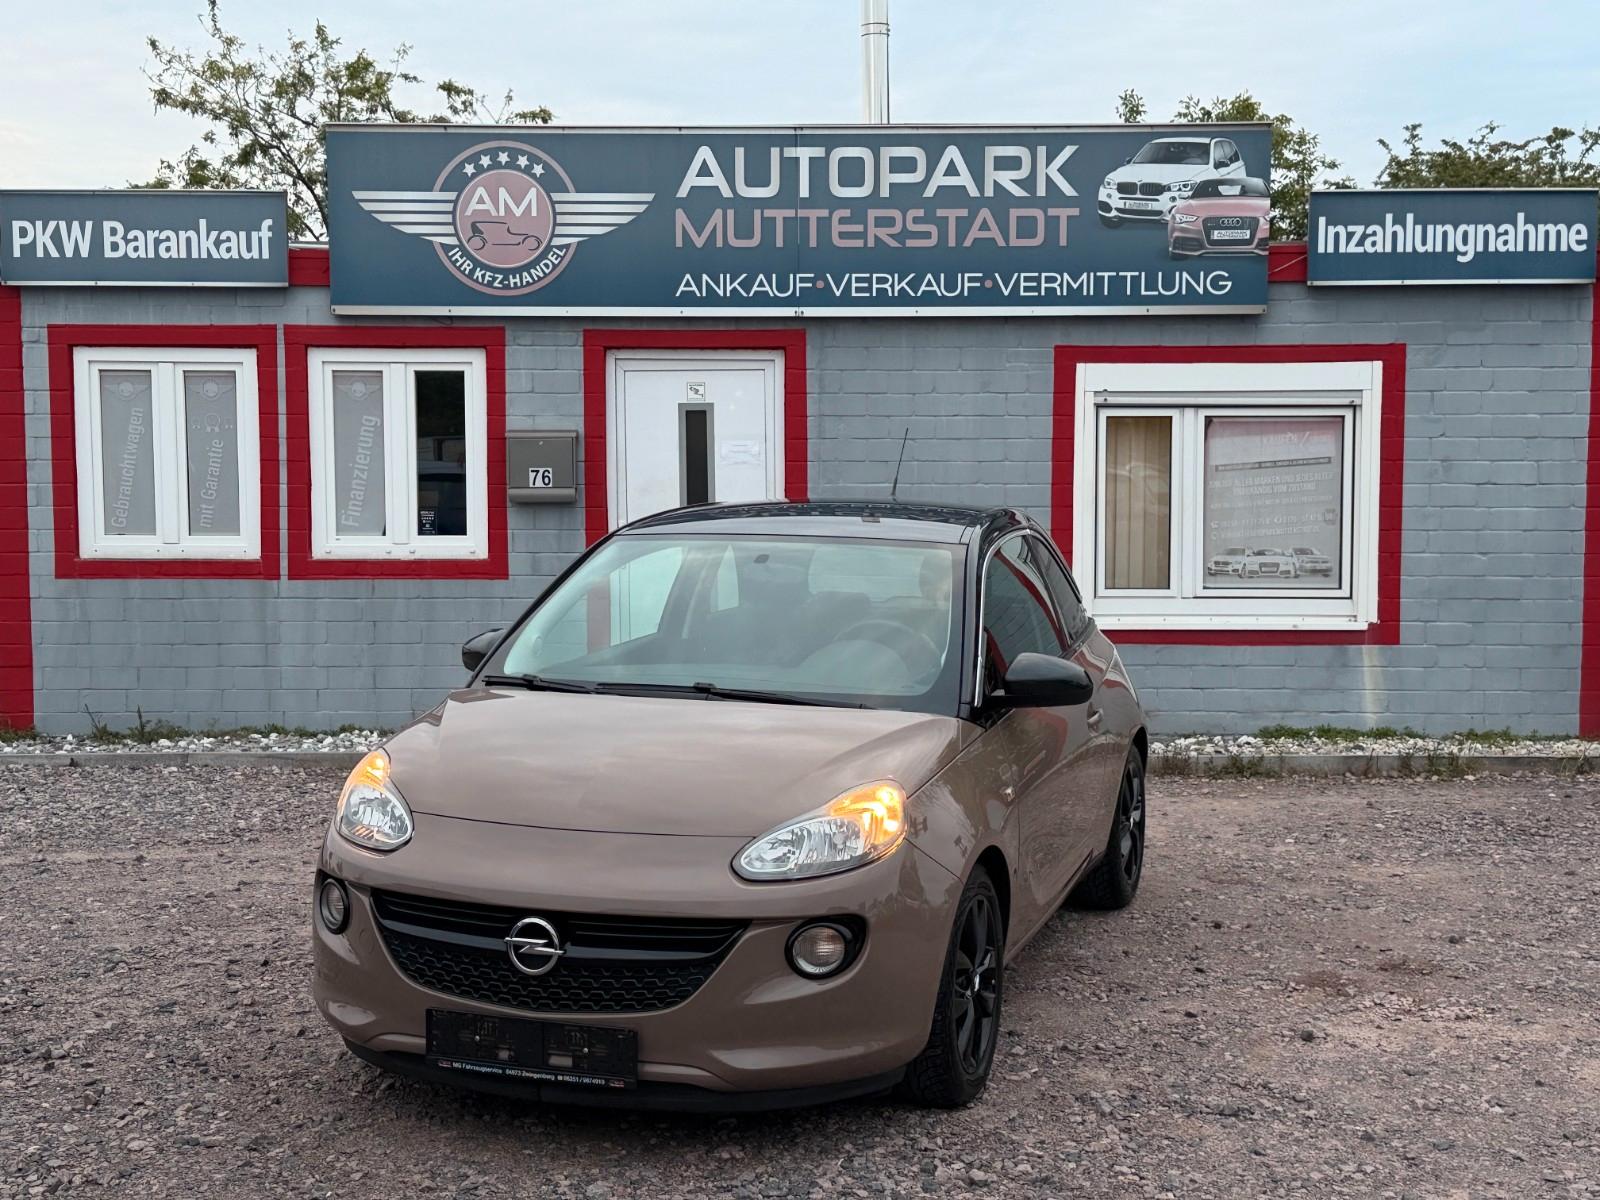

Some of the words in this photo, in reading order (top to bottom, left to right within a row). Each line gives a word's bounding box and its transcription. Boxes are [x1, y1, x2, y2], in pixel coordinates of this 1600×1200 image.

[676, 144, 1079, 198] AUTOPARK
[464, 186, 537, 217] AM
[11, 220, 93, 258] PKW
[103, 218, 273, 260] Barankauf
[676, 207, 1080, 249] MUTTERSTADT
[1317, 212, 1588, 263] Inzahlungnahme
[448, 246, 474, 275] IHR
[474, 245, 567, 288] KFZ-HANDEL
[676, 272, 814, 297] ANKAUF
[826, 271, 984, 297] VERKAUF
[995, 270, 1233, 297] VERMITTLUNG
[111, 407, 145, 528] Gebrauchtwagen
[201, 439, 224, 500] Garantie
[341, 415, 380, 527] Finanzierung
[530, 469, 551, 487] 76
[197, 503, 215, 528] mit
